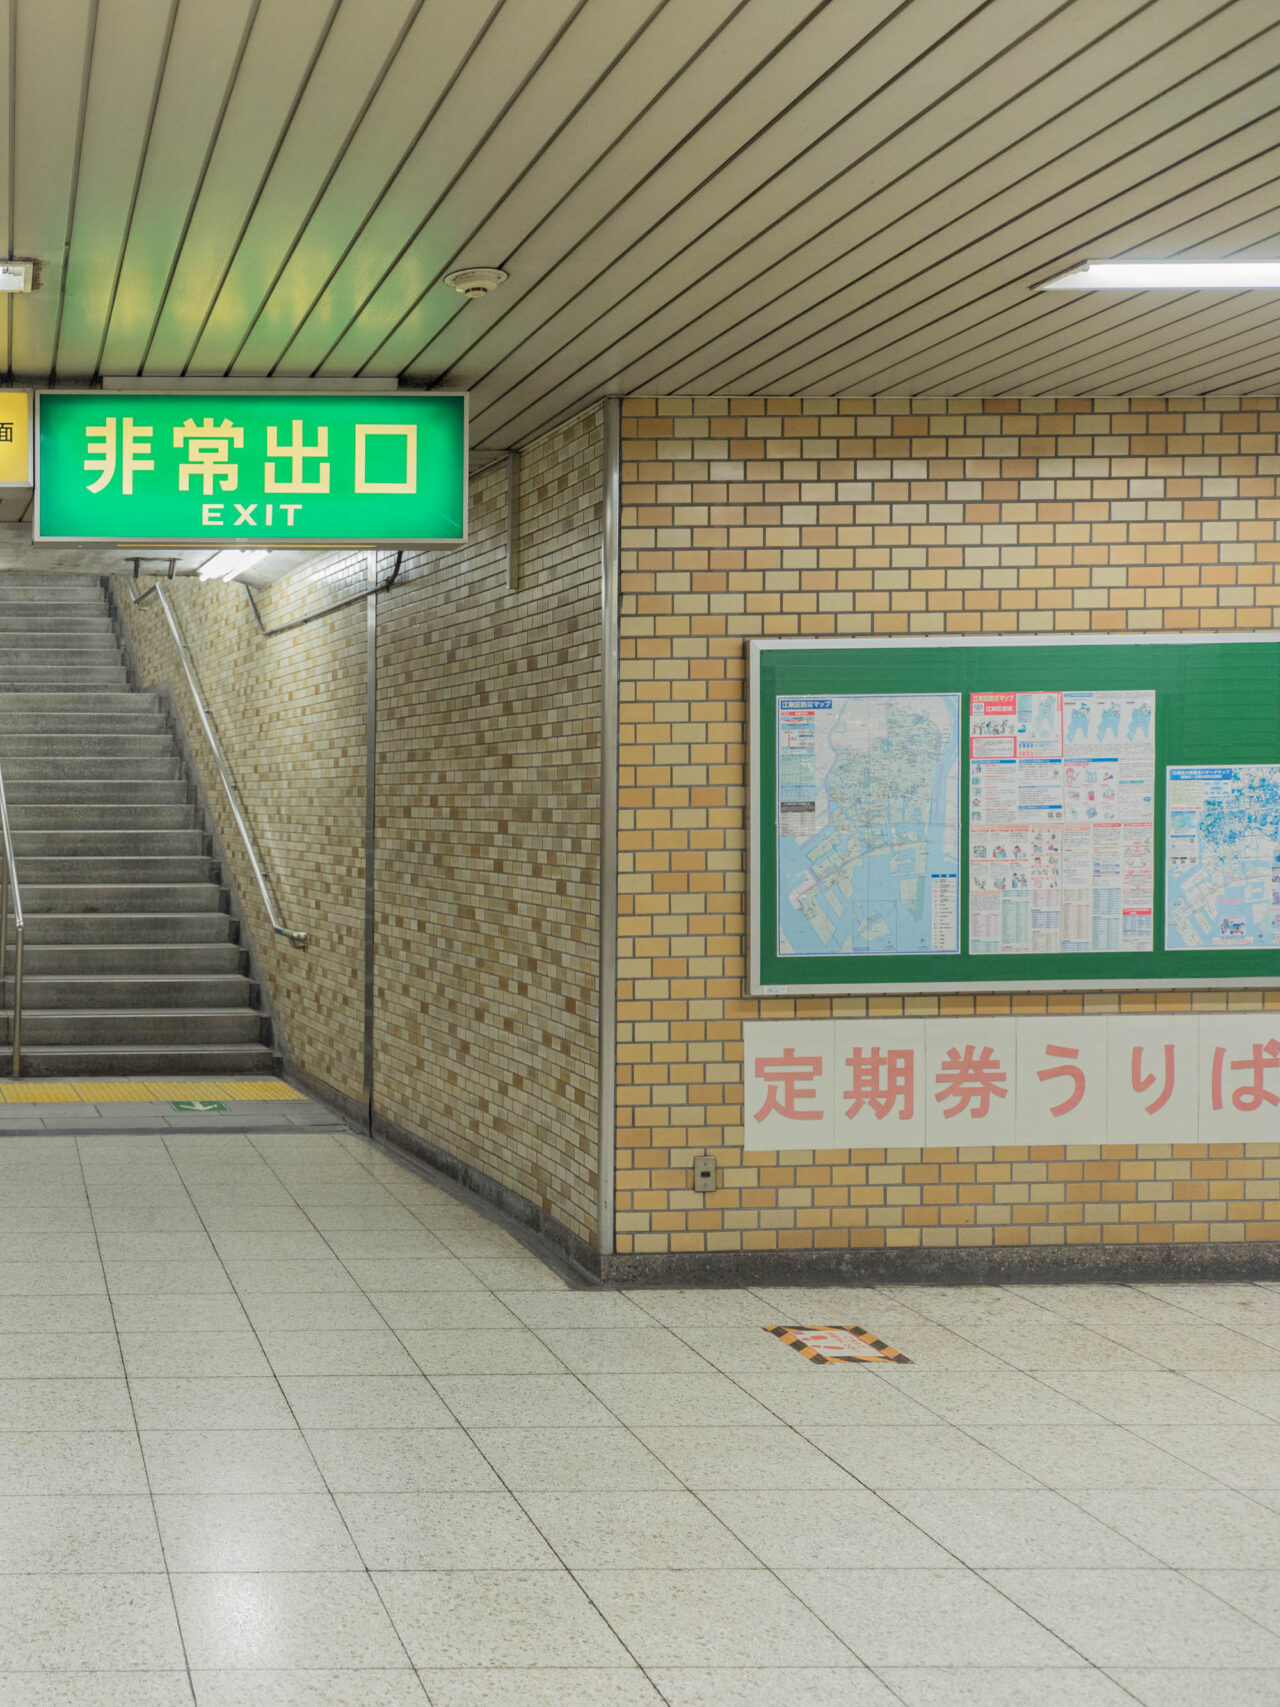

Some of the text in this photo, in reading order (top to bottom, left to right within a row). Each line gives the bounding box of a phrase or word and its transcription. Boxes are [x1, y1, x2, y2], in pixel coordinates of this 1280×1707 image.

[83, 417, 417, 495] 非常出口
[202, 504, 302, 526] EXIT
[753, 1038, 1280, 1124] 定期券うりば
